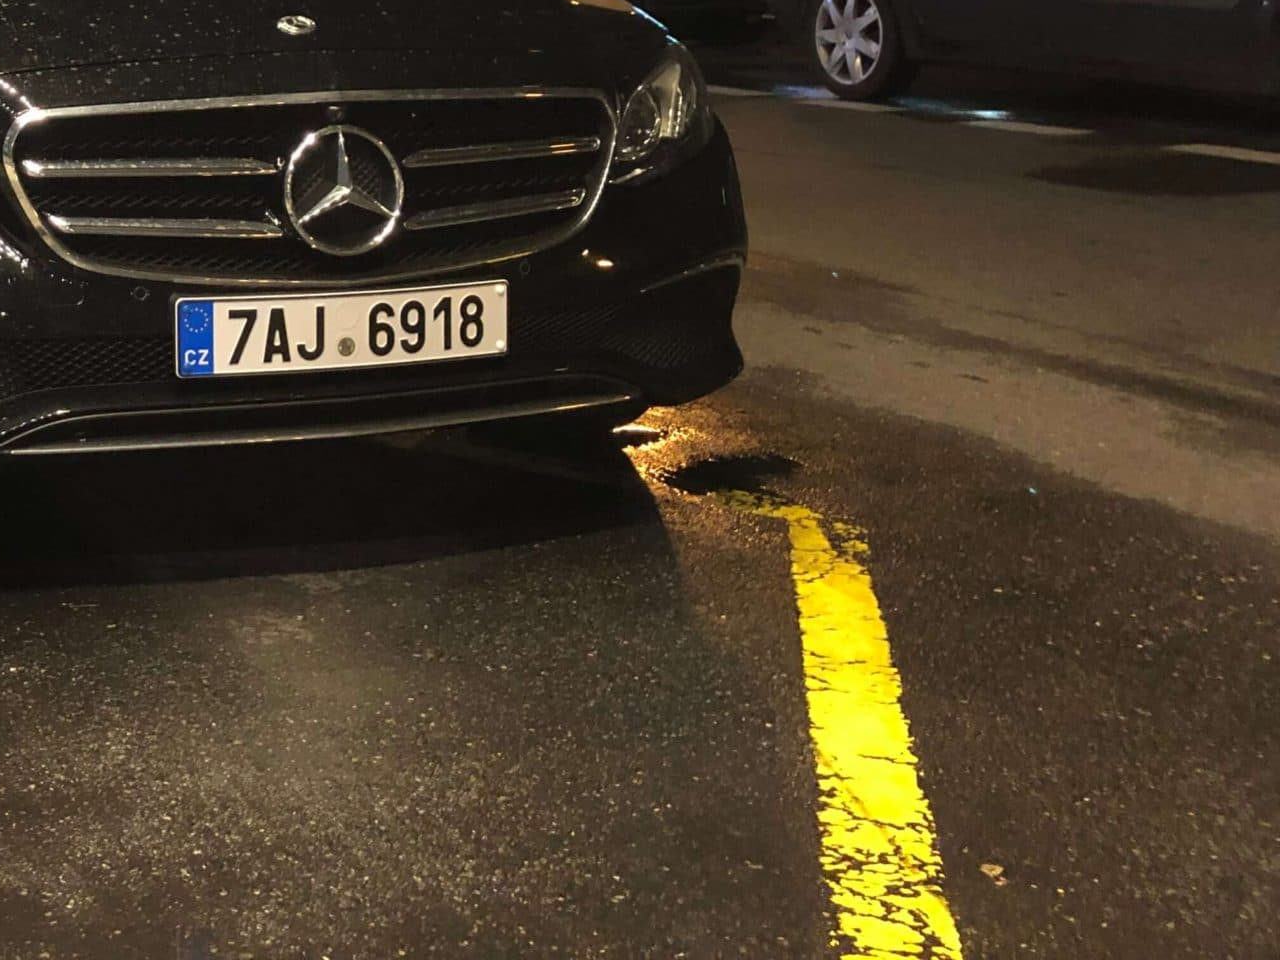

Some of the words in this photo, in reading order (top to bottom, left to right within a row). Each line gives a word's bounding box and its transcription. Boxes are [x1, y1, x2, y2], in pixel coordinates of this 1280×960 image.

[227, 305, 325, 366] 7AJ
[368, 294, 485, 357] 6918
[184, 348, 210, 367] CZ
